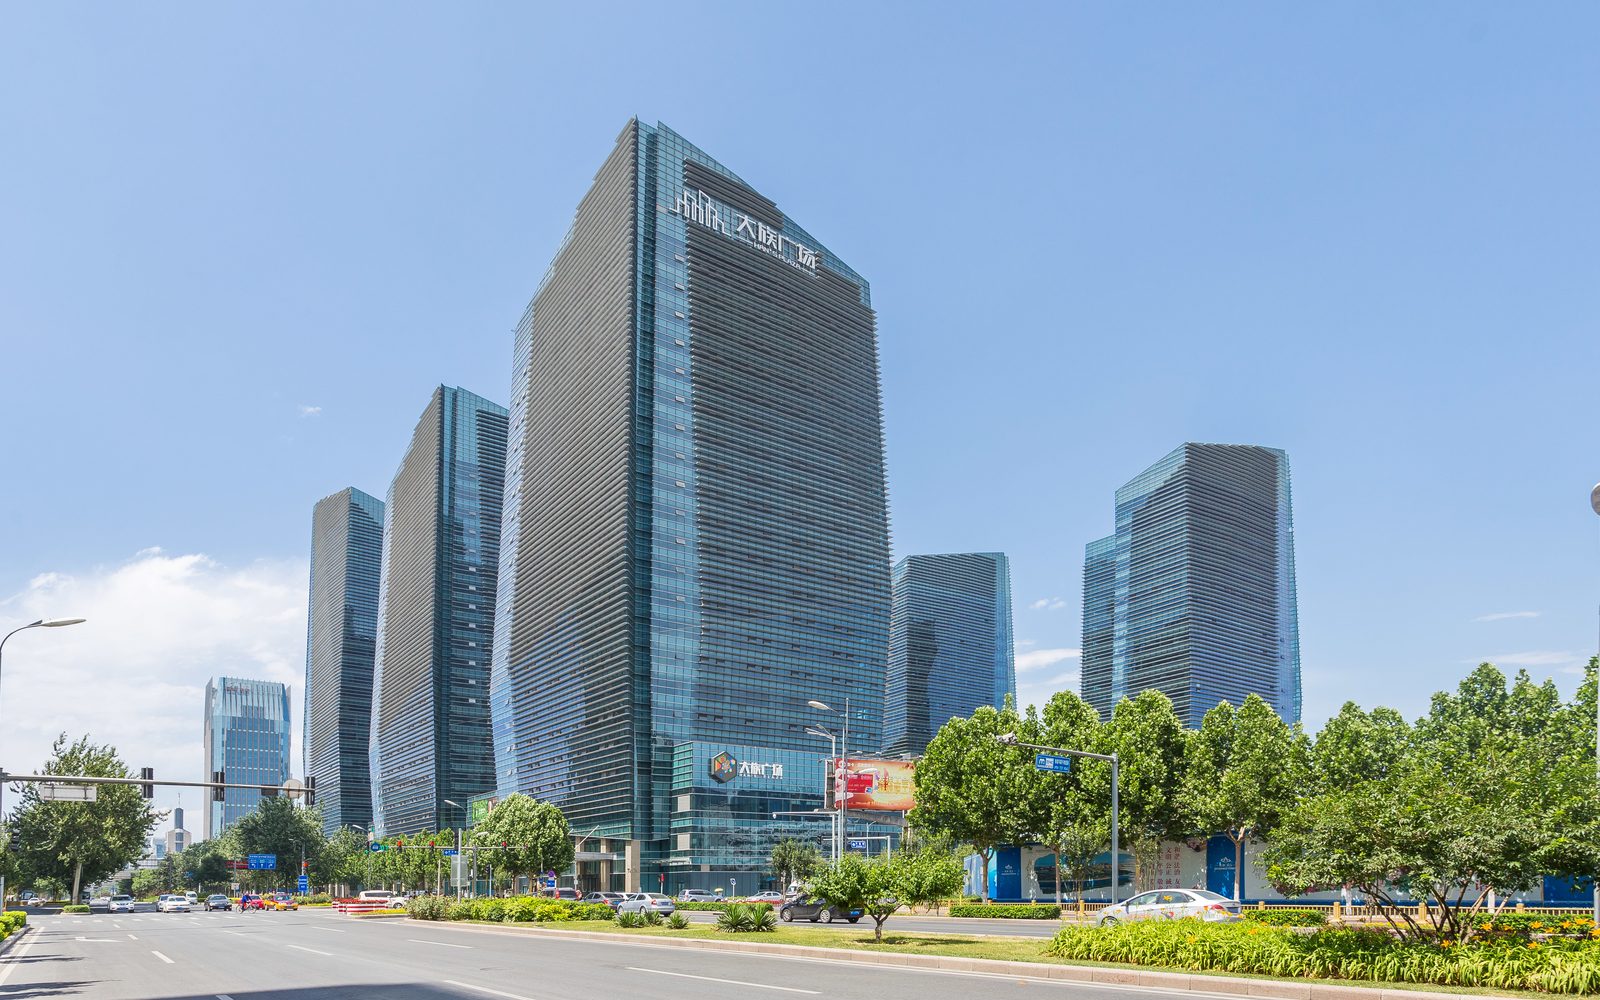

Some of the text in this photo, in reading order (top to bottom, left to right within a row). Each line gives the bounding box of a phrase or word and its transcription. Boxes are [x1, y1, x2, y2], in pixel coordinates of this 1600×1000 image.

[736, 214, 816, 269] 大族广场
[753, 242, 801, 269] HAN'S PLAZA
[739, 761, 783, 777] 大族广场
